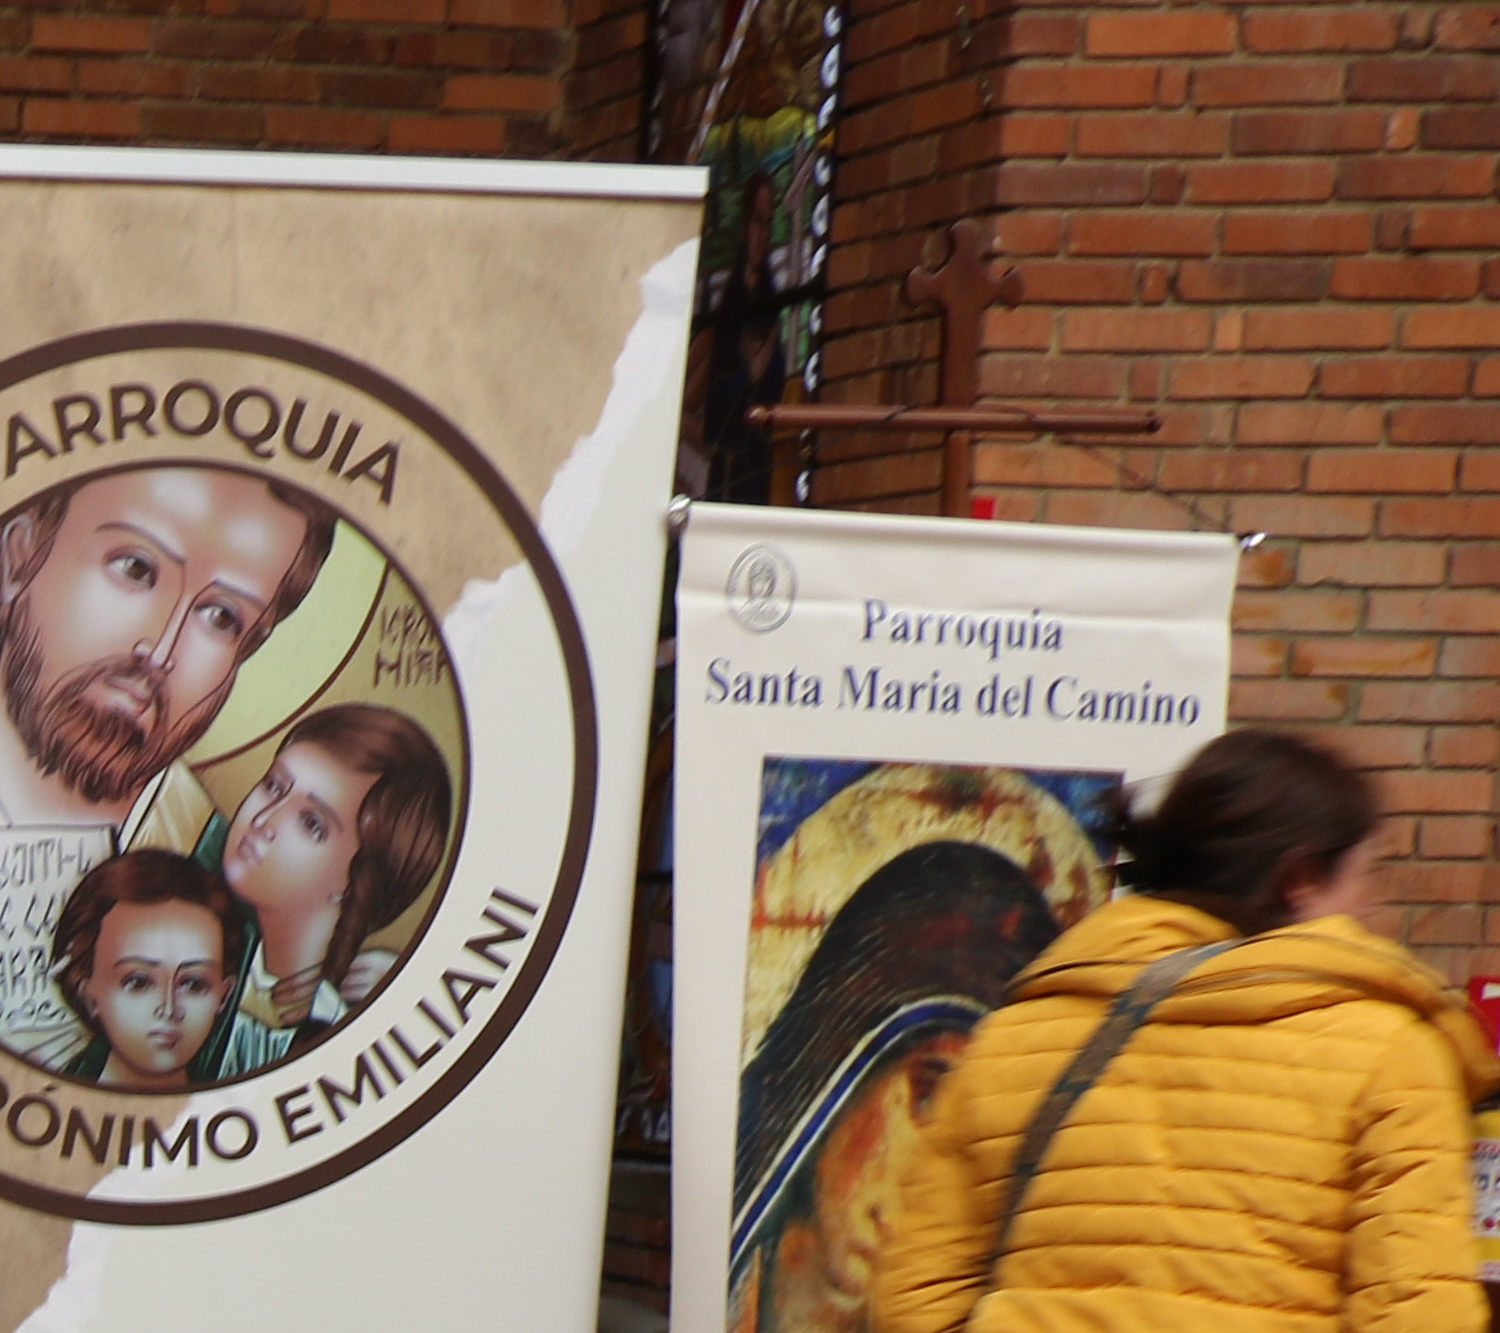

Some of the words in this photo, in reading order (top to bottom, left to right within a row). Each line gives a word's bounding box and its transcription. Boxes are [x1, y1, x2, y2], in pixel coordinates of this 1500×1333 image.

[861, 597, 1065, 661] Parroquia
[704, 657, 824, 708] Santa
[975, 674, 1035, 717] del
[1046, 673, 1201, 727] Camino
[276, 887, 542, 1145] EMILIANI
